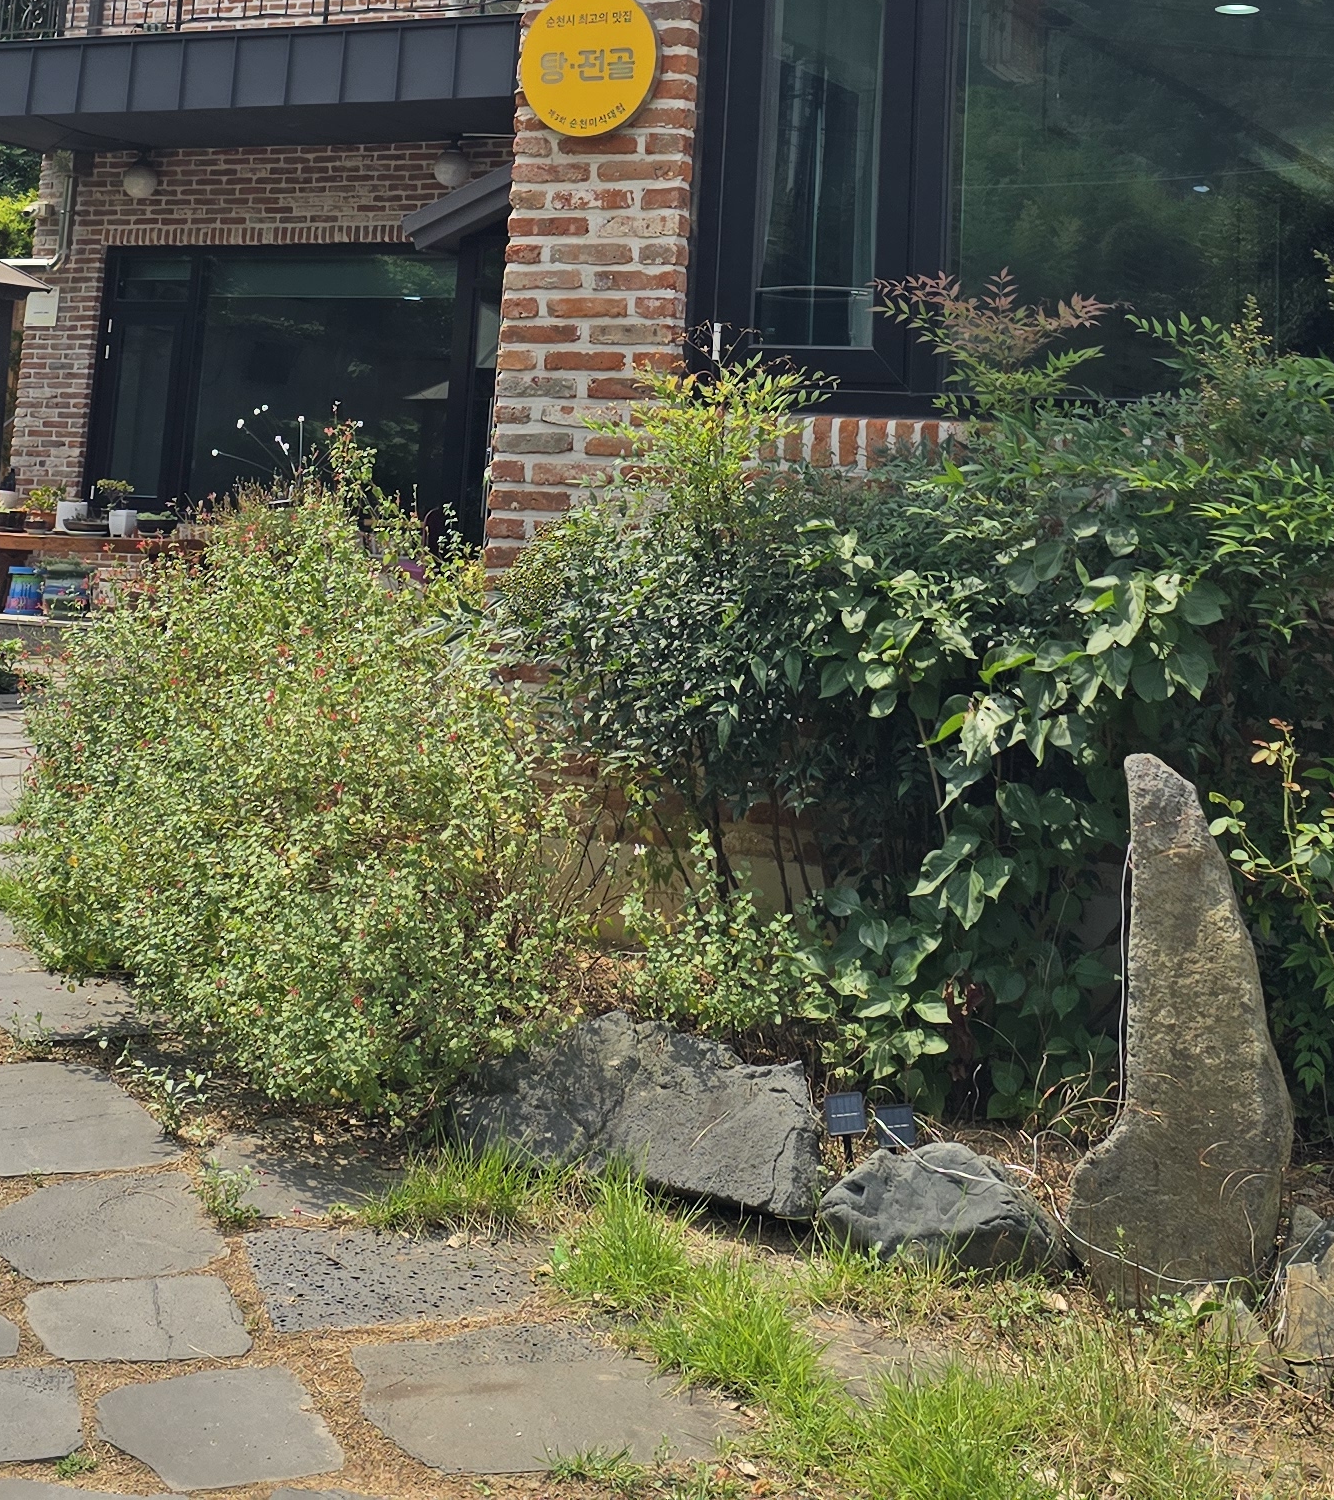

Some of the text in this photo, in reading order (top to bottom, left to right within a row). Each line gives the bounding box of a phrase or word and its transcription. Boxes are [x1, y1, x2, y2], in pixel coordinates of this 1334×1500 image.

[546, 10, 632, 28] 순천시 최고의 맛집
